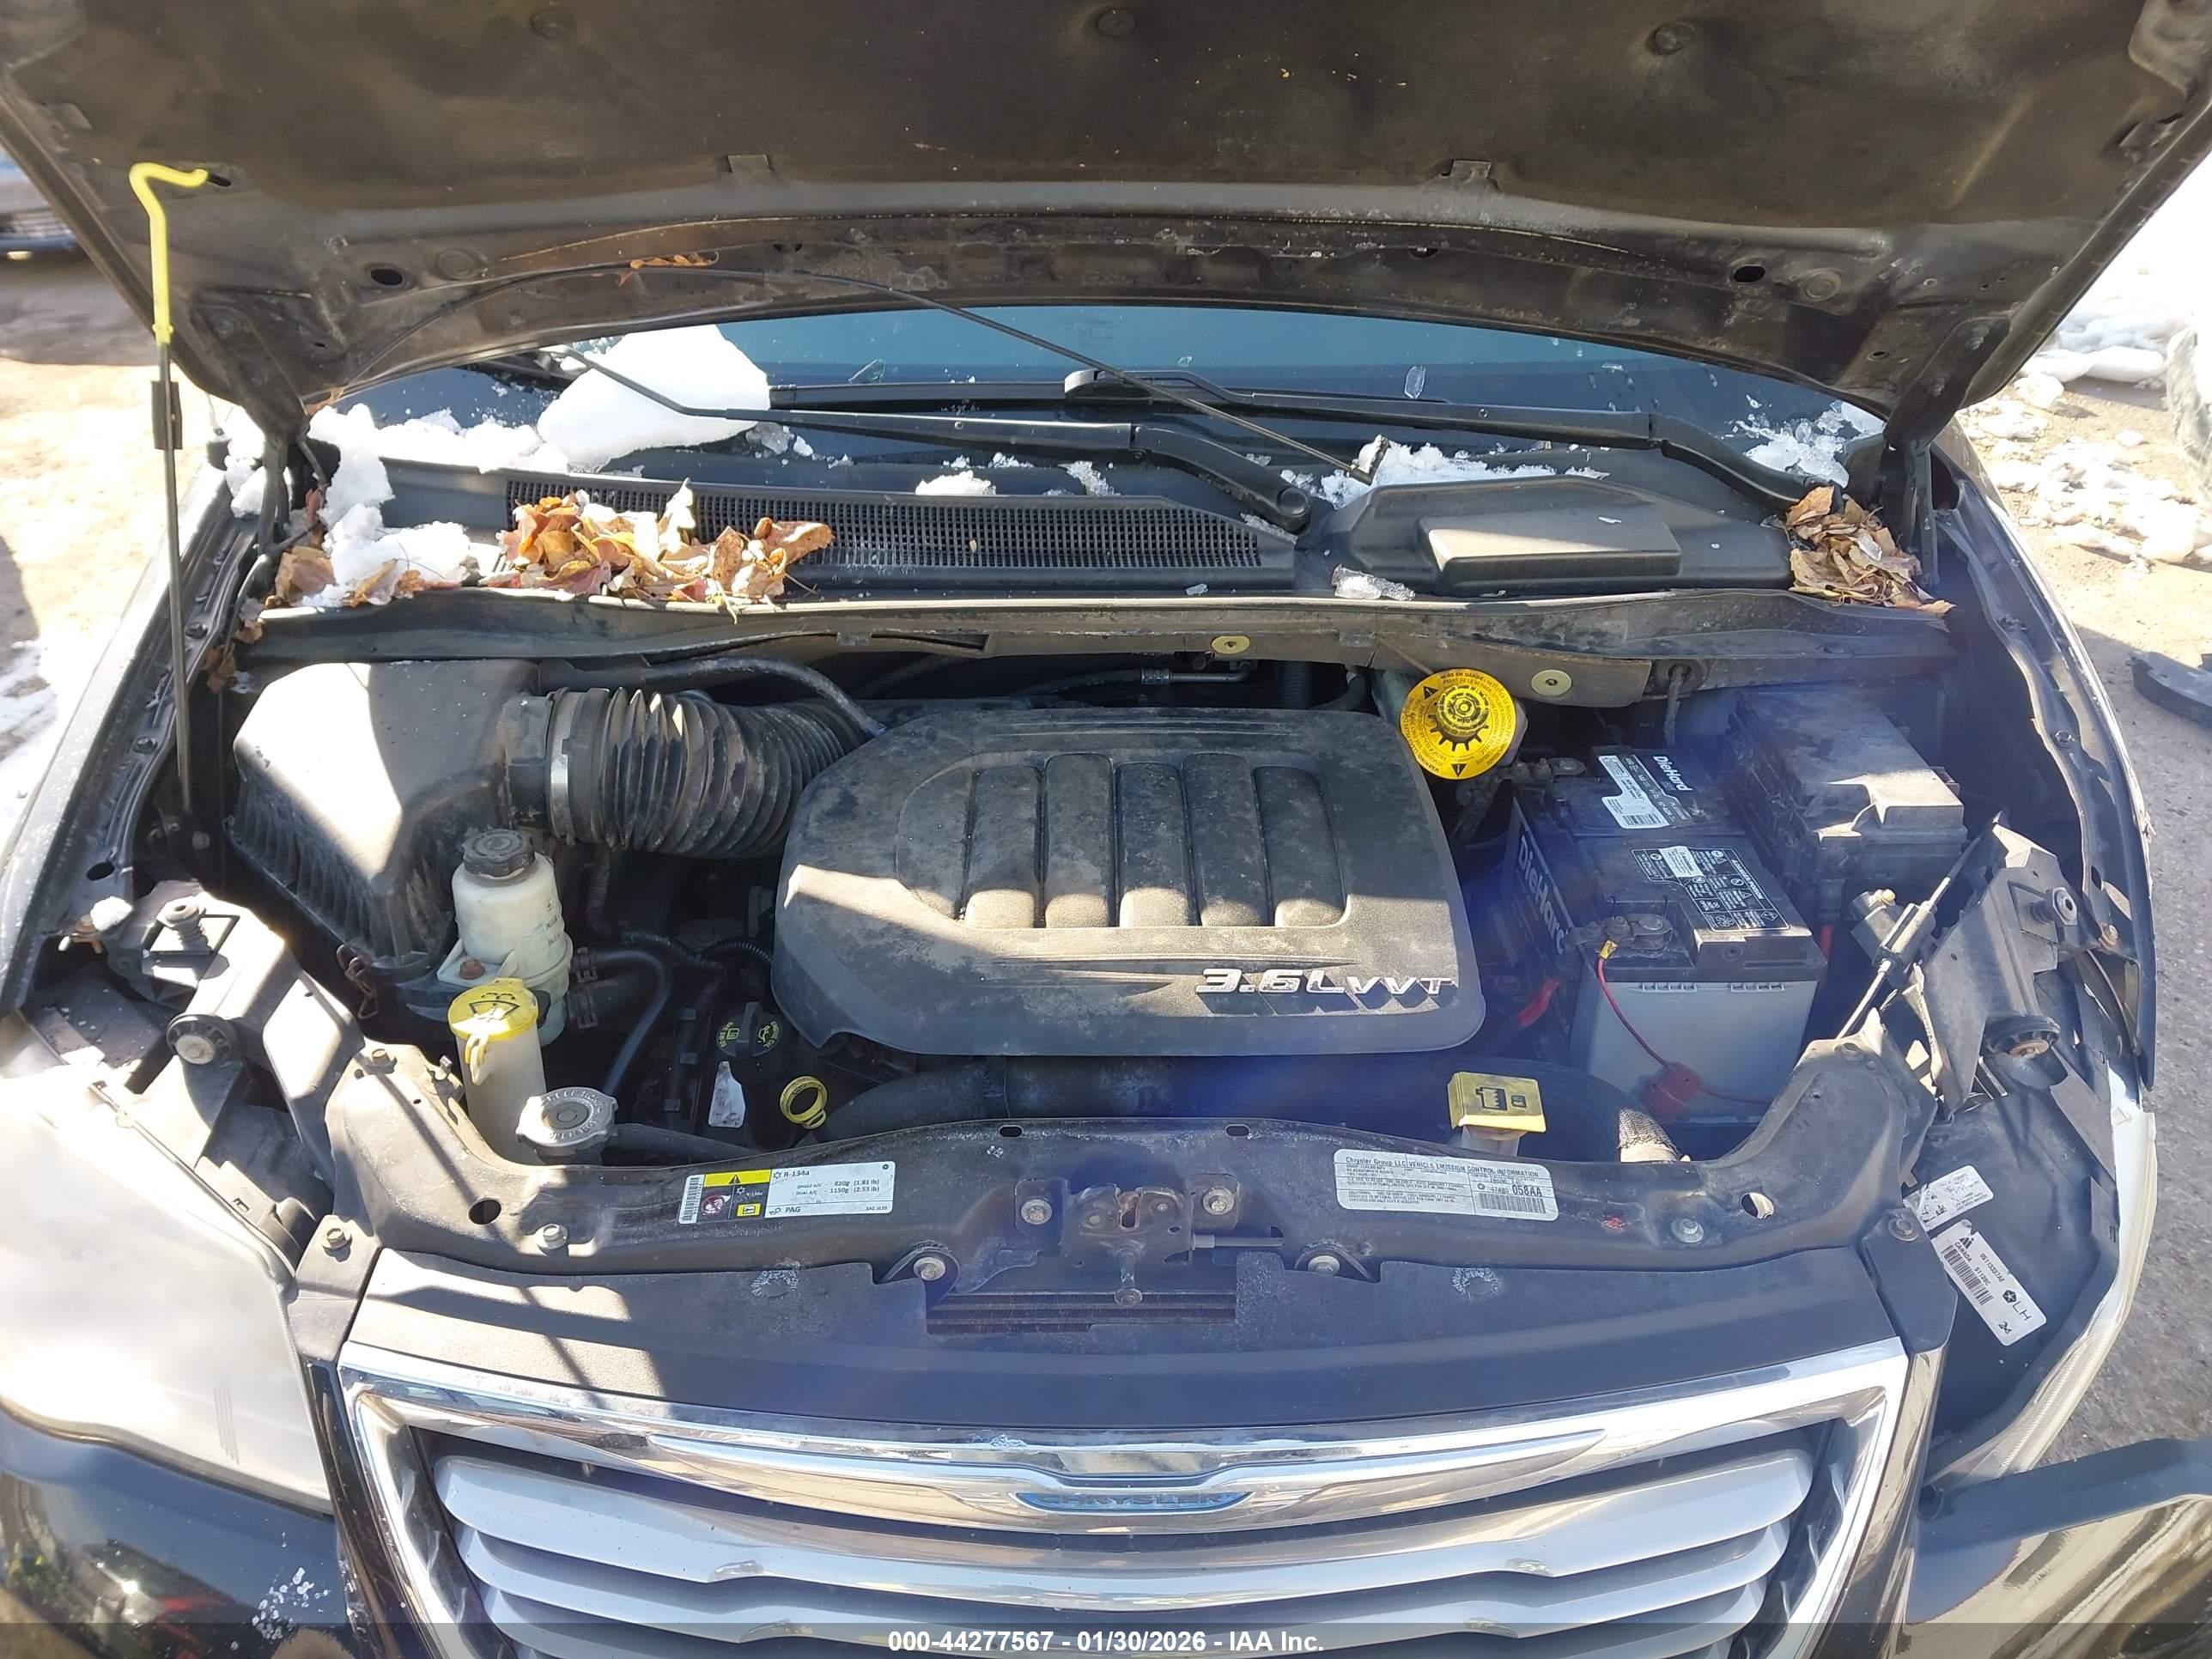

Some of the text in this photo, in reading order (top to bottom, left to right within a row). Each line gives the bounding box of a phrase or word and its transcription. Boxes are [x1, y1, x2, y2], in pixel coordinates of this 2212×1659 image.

[1653, 756, 1694, 791] DieHard
[1196, 968, 1456, 995] 3.6L VVT
[1346, 1156, 1372, 1165] Chrysler
[1373, 1158, 1393, 1167] Group
[1408, 1161, 1434, 1170] VEHICLE
[1436, 1163, 1465, 1171] EMISSION
[1467, 1165, 1494, 1174] CONTROL
[1497, 1169, 1539, 1177] INFORMATION
[1511, 1184, 1543, 1198] 058AA
[1954, 1242, 1972, 1263] CANADA
[2014, 1300, 2033, 1321] LH
